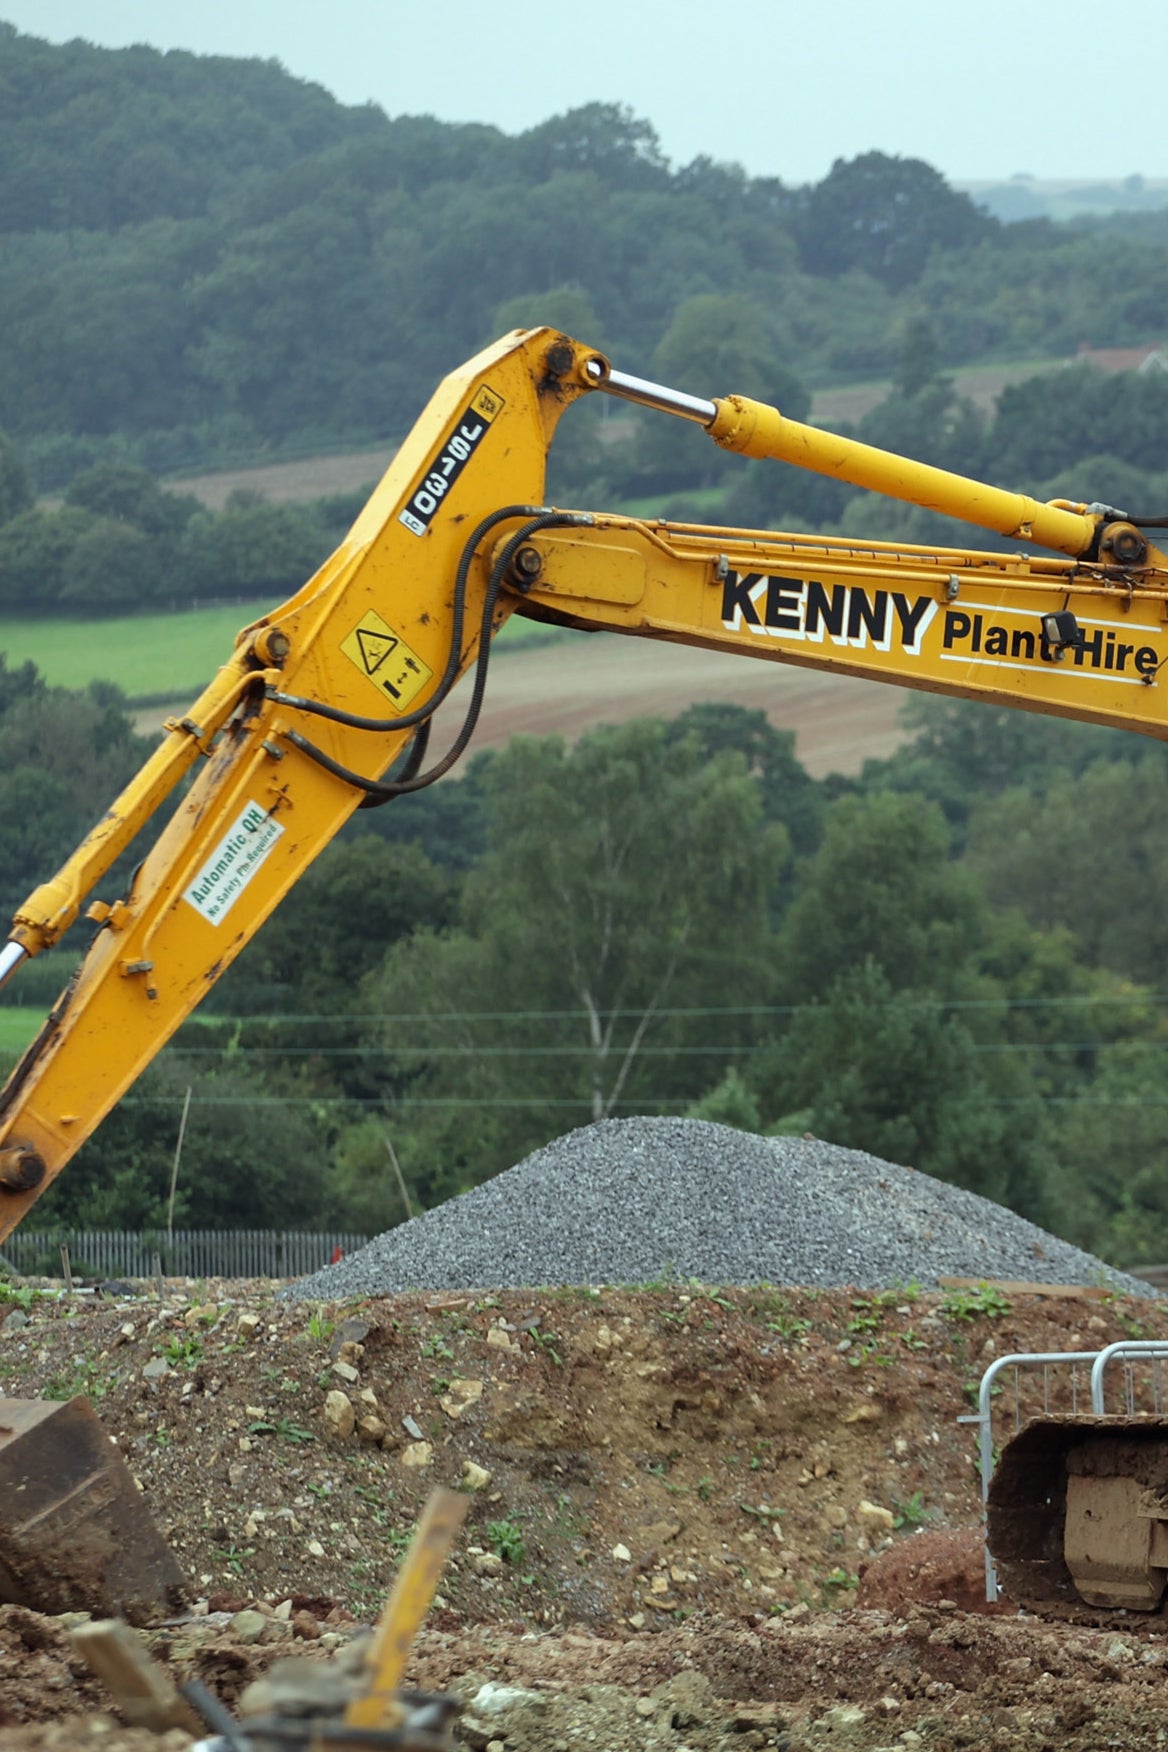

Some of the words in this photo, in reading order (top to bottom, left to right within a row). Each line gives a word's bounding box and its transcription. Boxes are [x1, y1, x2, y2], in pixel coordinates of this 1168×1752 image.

[413, 424, 483, 515] JS130
[721, 570, 937, 653] KENNY
[942, 610, 1053, 663] Plant
[1072, 628, 1158, 675] Hire
[191, 834, 248, 904] Automatic
[207, 905, 220, 917] No
[217, 877, 242, 904] Safety
[247, 824, 278, 863] Required
